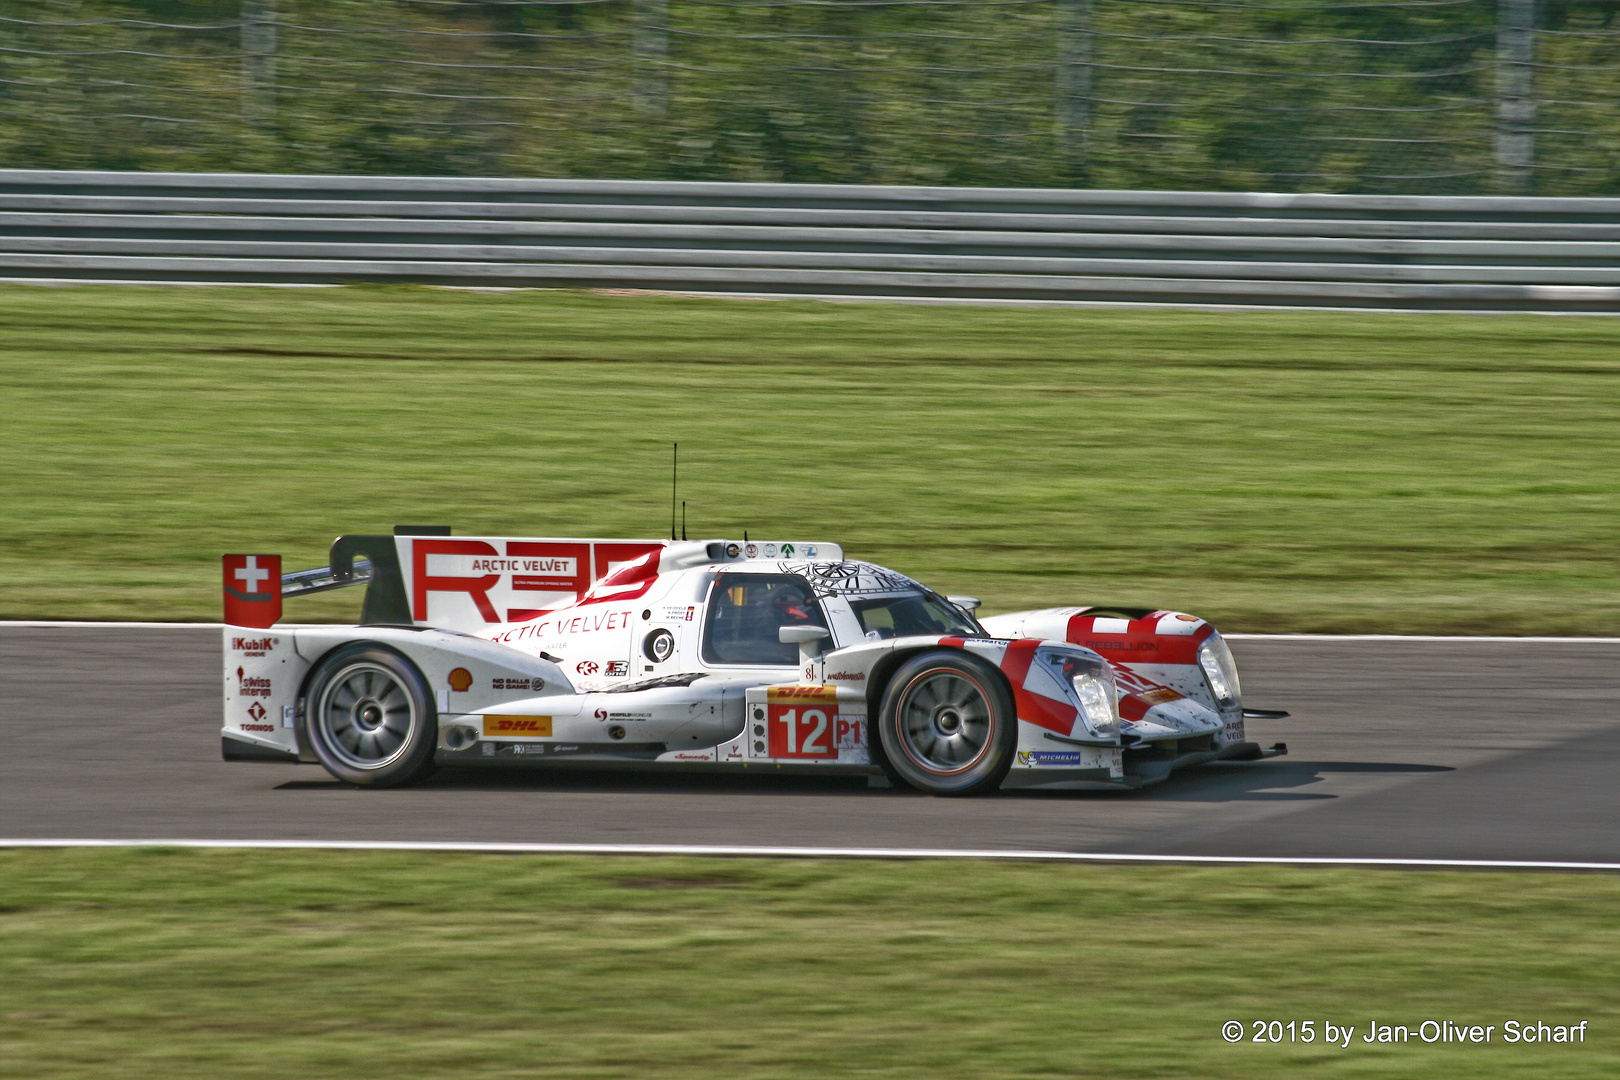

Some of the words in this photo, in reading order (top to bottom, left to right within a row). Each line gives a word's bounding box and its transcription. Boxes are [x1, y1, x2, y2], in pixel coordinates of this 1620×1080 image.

[472, 559, 519, 573] ARCTIC
[522, 559, 569, 572] VELVET
[491, 622, 549, 643] RCTIC
[557, 610, 632, 635] VELVET
[243, 678, 272, 688] swiss
[776, 687, 827, 698] DHL
[498, 720, 541, 731] DHL
[779, 708, 828, 754] 12
[836, 720, 861, 745] P1
[674, 753, 711, 761] Speedy
